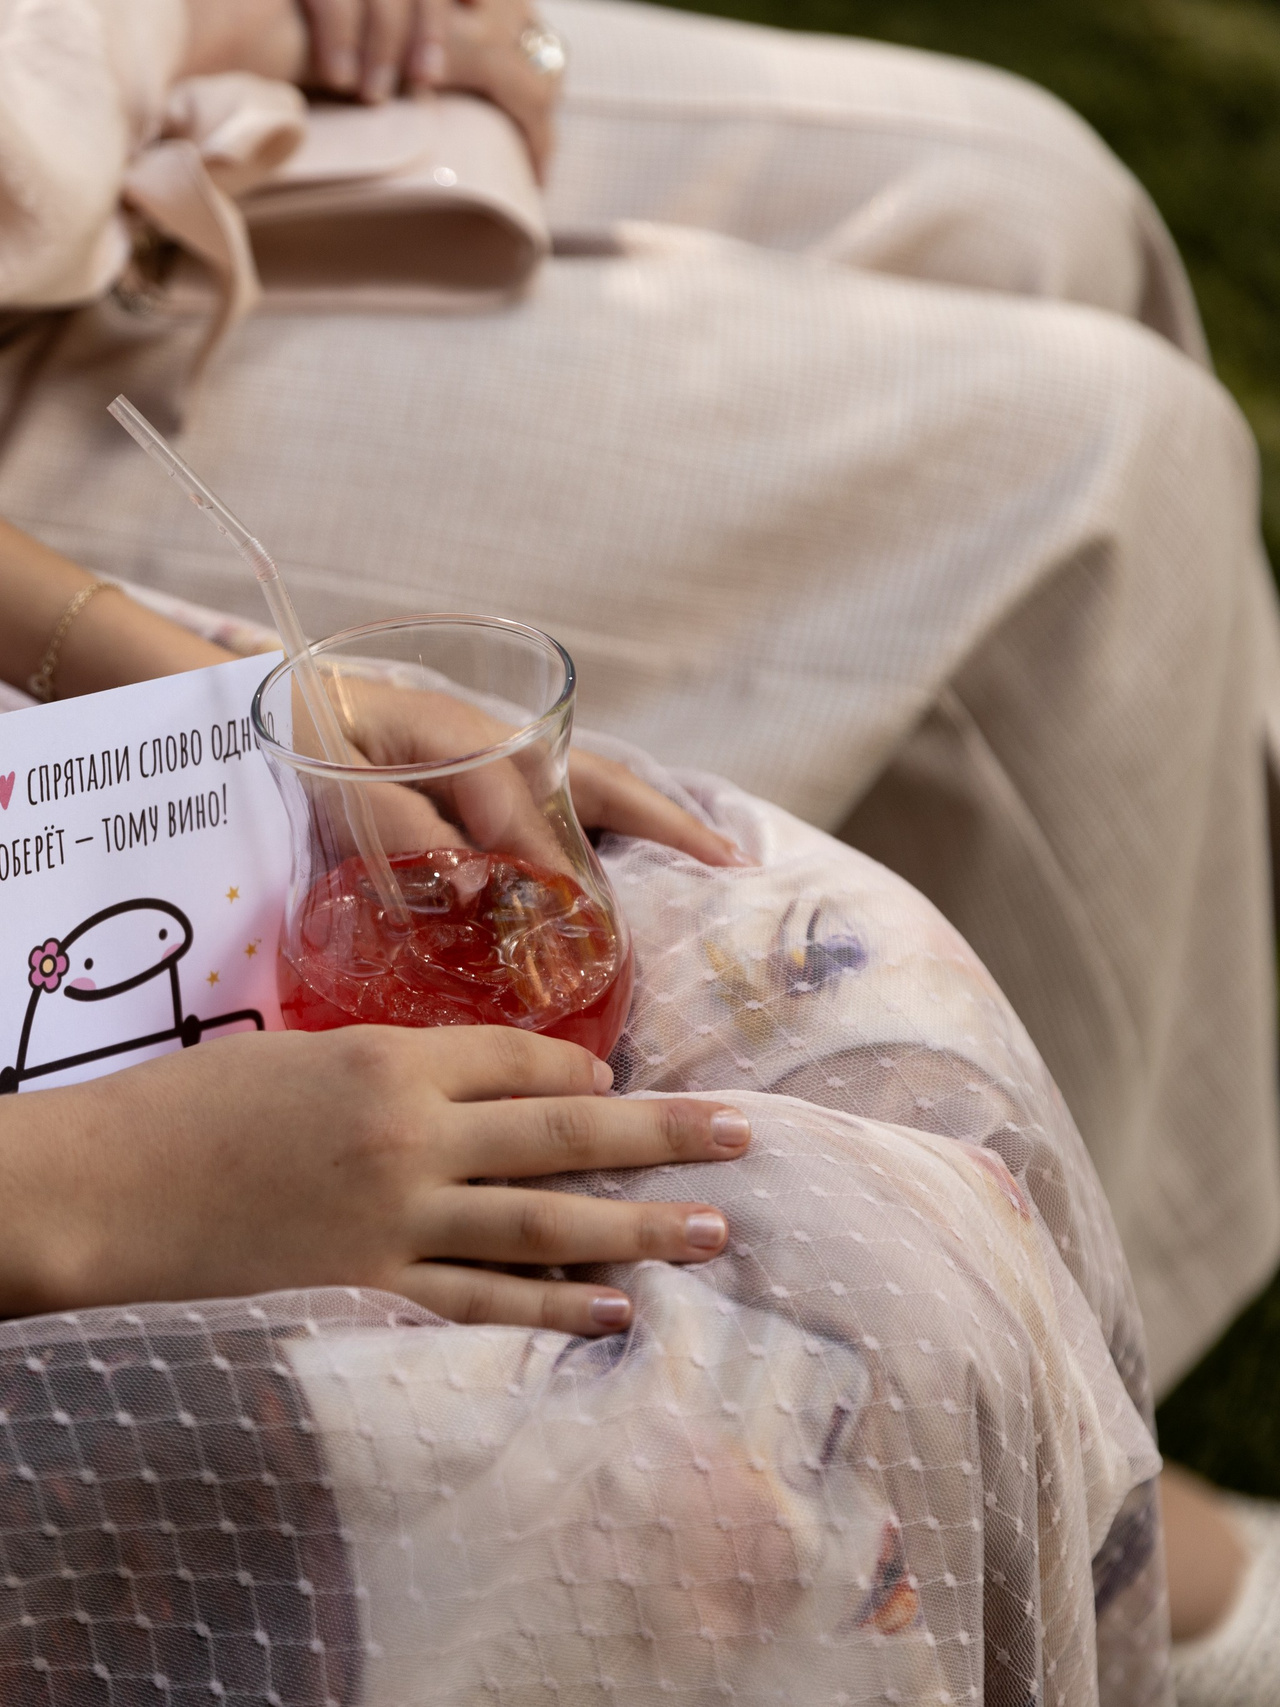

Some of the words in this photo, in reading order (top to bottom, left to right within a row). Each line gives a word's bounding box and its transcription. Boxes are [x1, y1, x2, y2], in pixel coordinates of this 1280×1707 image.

[27, 745, 130, 806] СПРЯТАЛИ
[139, 729, 202, 778] СЛОВО
[101, 804, 158, 853] ТОМУ
[168, 782, 228, 838] ВИНО!
